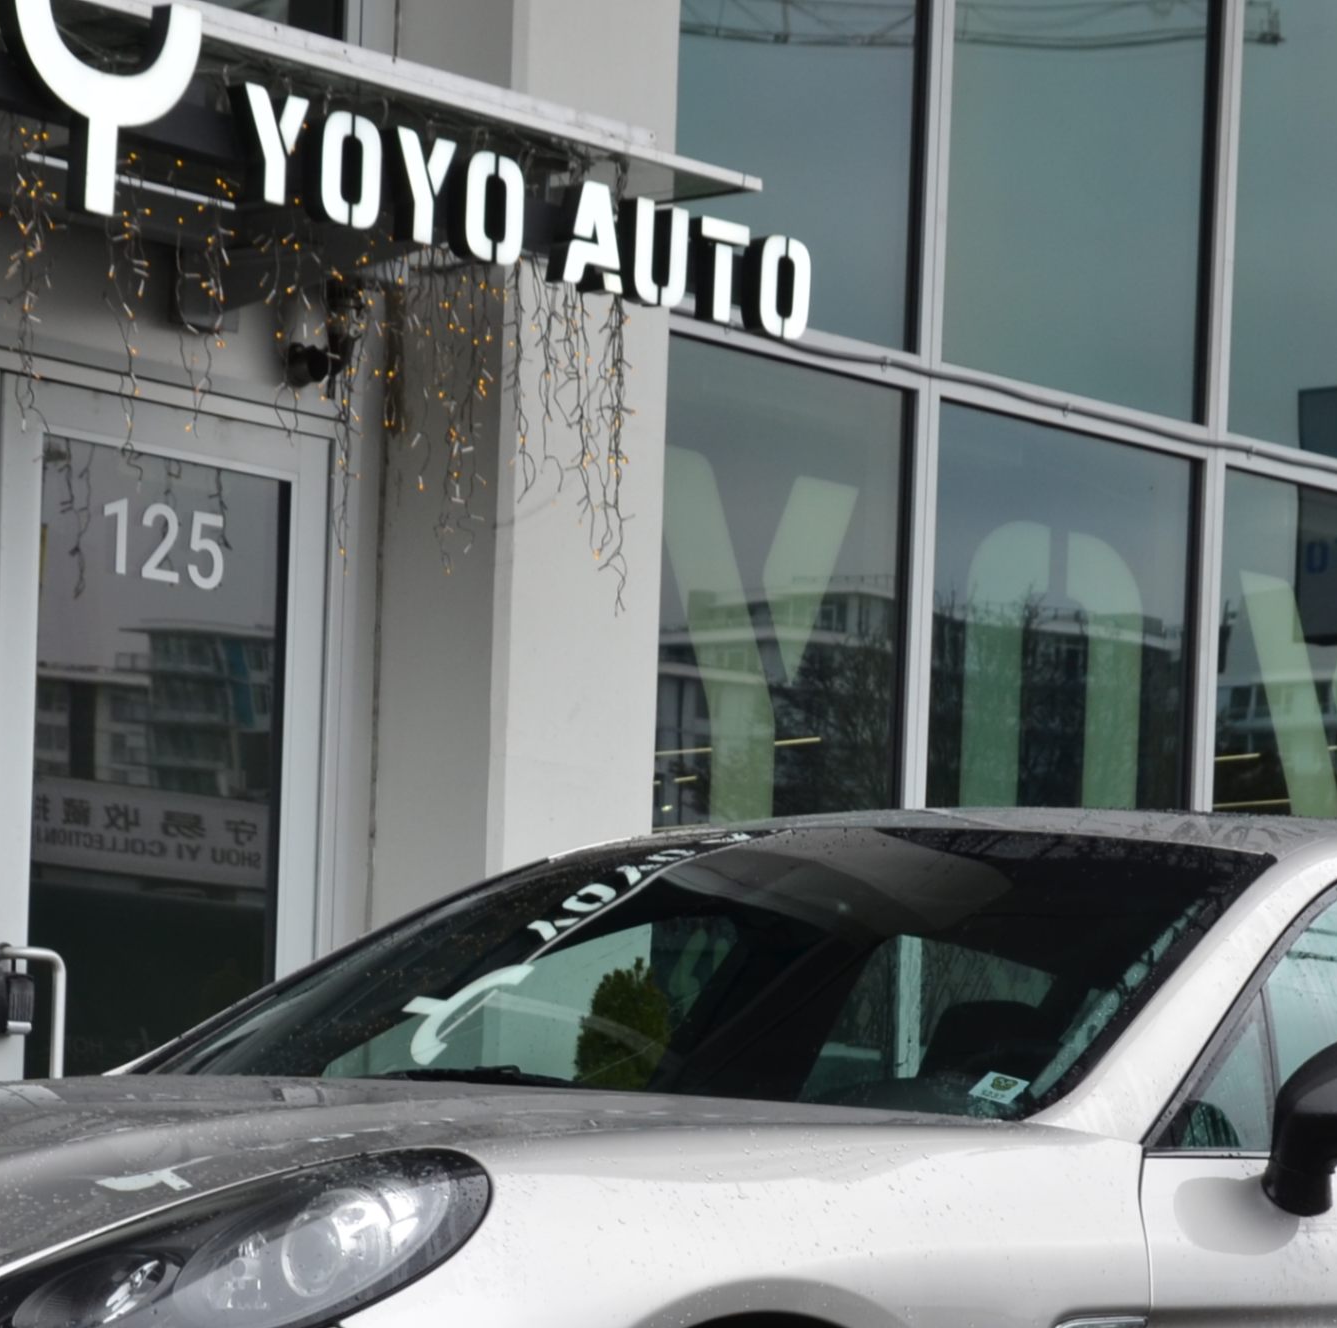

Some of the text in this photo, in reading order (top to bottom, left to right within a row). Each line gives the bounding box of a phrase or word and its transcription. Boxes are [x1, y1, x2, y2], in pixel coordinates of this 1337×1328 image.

[244, 81, 811, 340] YOYO AUTO
[102, 497, 225, 591] 125
